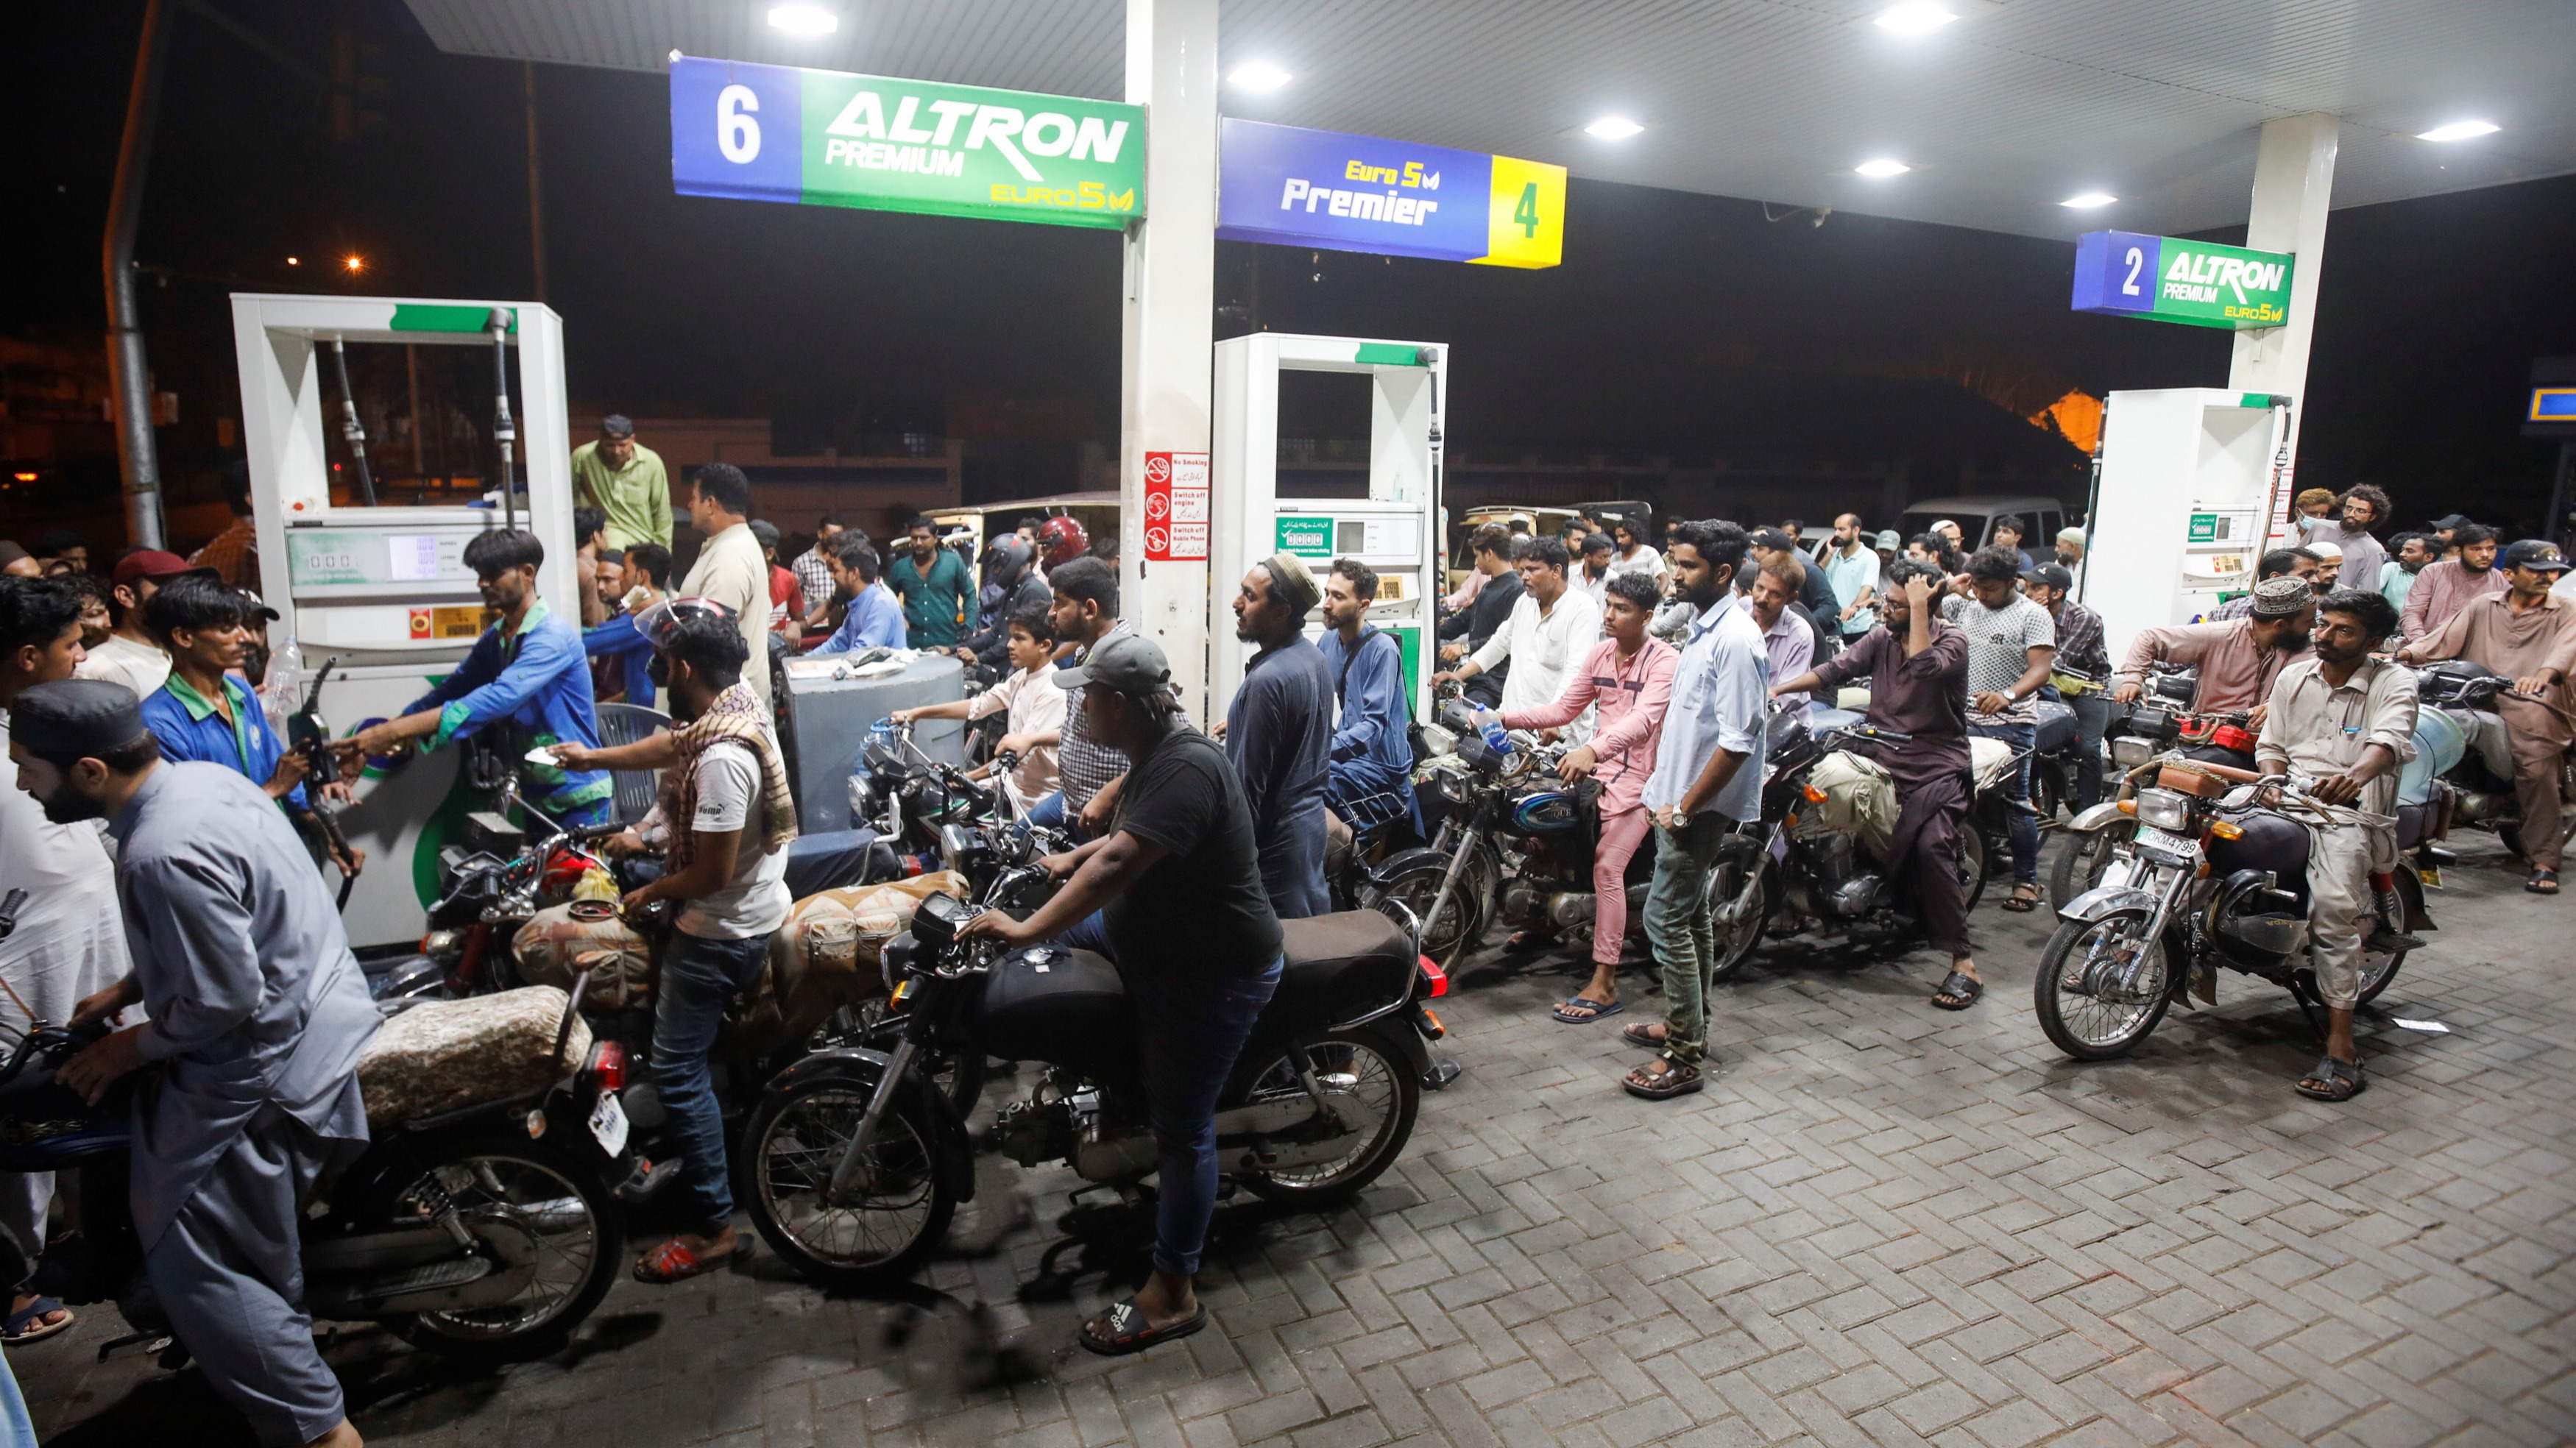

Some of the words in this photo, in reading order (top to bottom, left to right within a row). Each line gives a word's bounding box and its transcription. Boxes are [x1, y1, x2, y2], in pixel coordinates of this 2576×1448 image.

[717, 84, 761, 164] 6
[825, 90, 1130, 182] ALTRON
[824, 139, 965, 178] PREMIUM
[1281, 177, 1437, 226] Premier
[1513, 182, 1539, 238] 4
[2122, 247, 2143, 297] 2
[2162, 282, 2218, 304] PREMIUM
[2165, 252, 2285, 305] ALTRON
[1183, 459, 1208, 467] Smoking
[698, 806, 721, 815] PUMA
